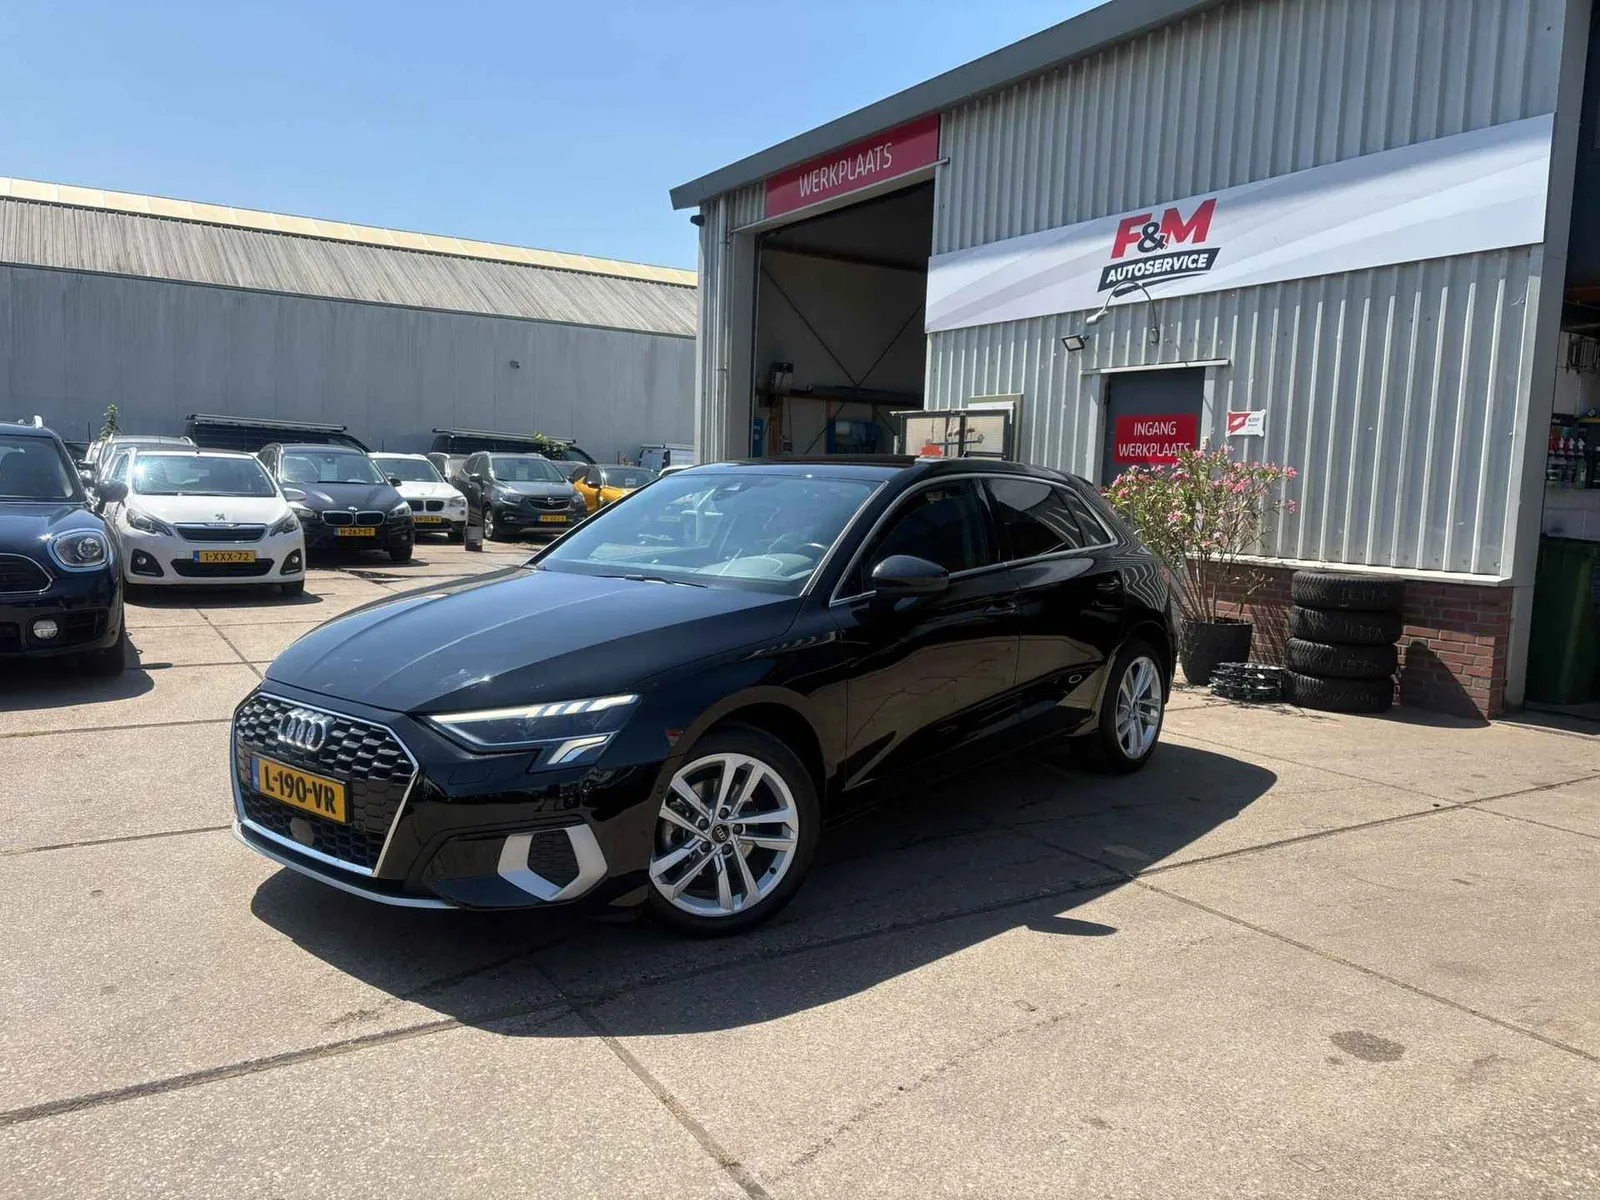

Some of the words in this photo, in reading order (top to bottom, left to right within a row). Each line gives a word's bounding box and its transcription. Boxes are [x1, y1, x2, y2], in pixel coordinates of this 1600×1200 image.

[799, 142, 893, 197] WERKPLAATS
[1110, 198, 1217, 260] F&M
[1105, 253, 1209, 284] AUTOSERVICE
[1133, 420, 1177, 436] INGANG
[205, 552, 250, 561] 1-XXX-72
[264, 764, 337, 815] L-190-VR
